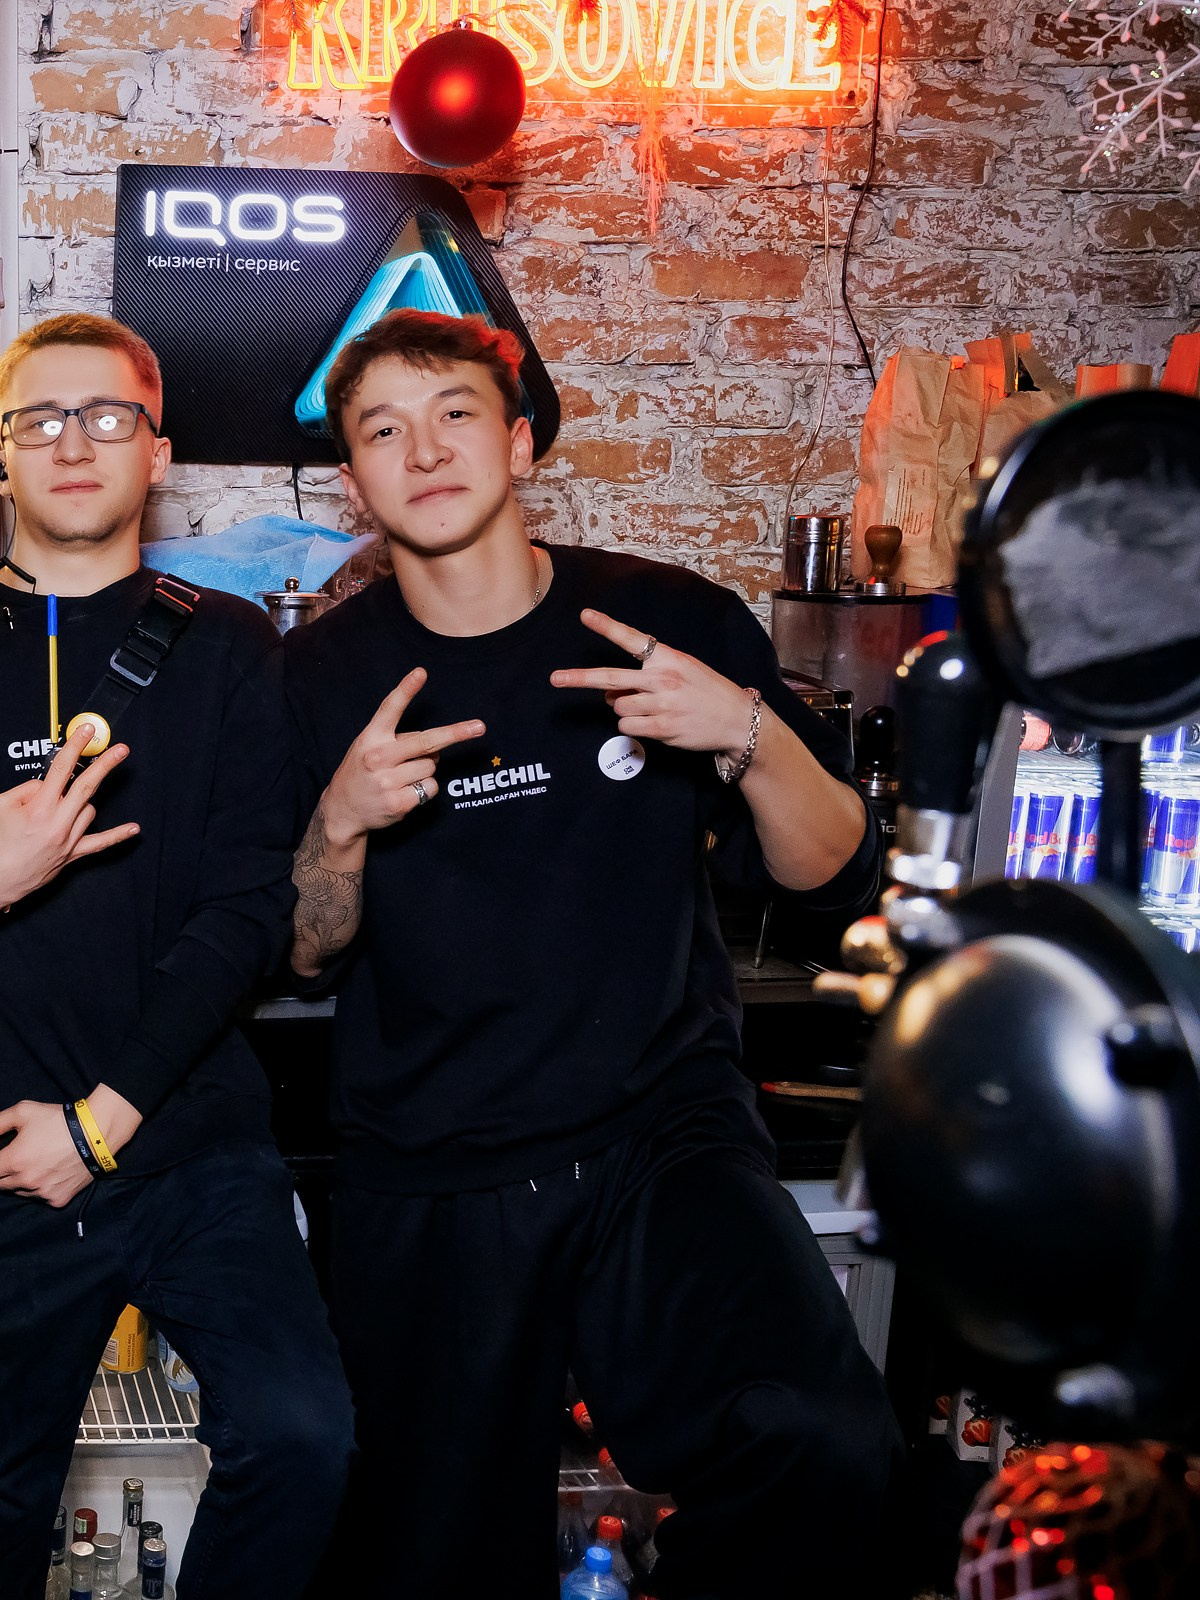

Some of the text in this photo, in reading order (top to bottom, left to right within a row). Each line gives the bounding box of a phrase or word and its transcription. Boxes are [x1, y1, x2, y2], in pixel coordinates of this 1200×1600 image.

[145, 190, 345, 246] IQOS
[147, 253, 300, 274] қызметі сервис
[605, 758, 621, 770] ШЕФ
[447, 762, 551, 797] CHECHIL
